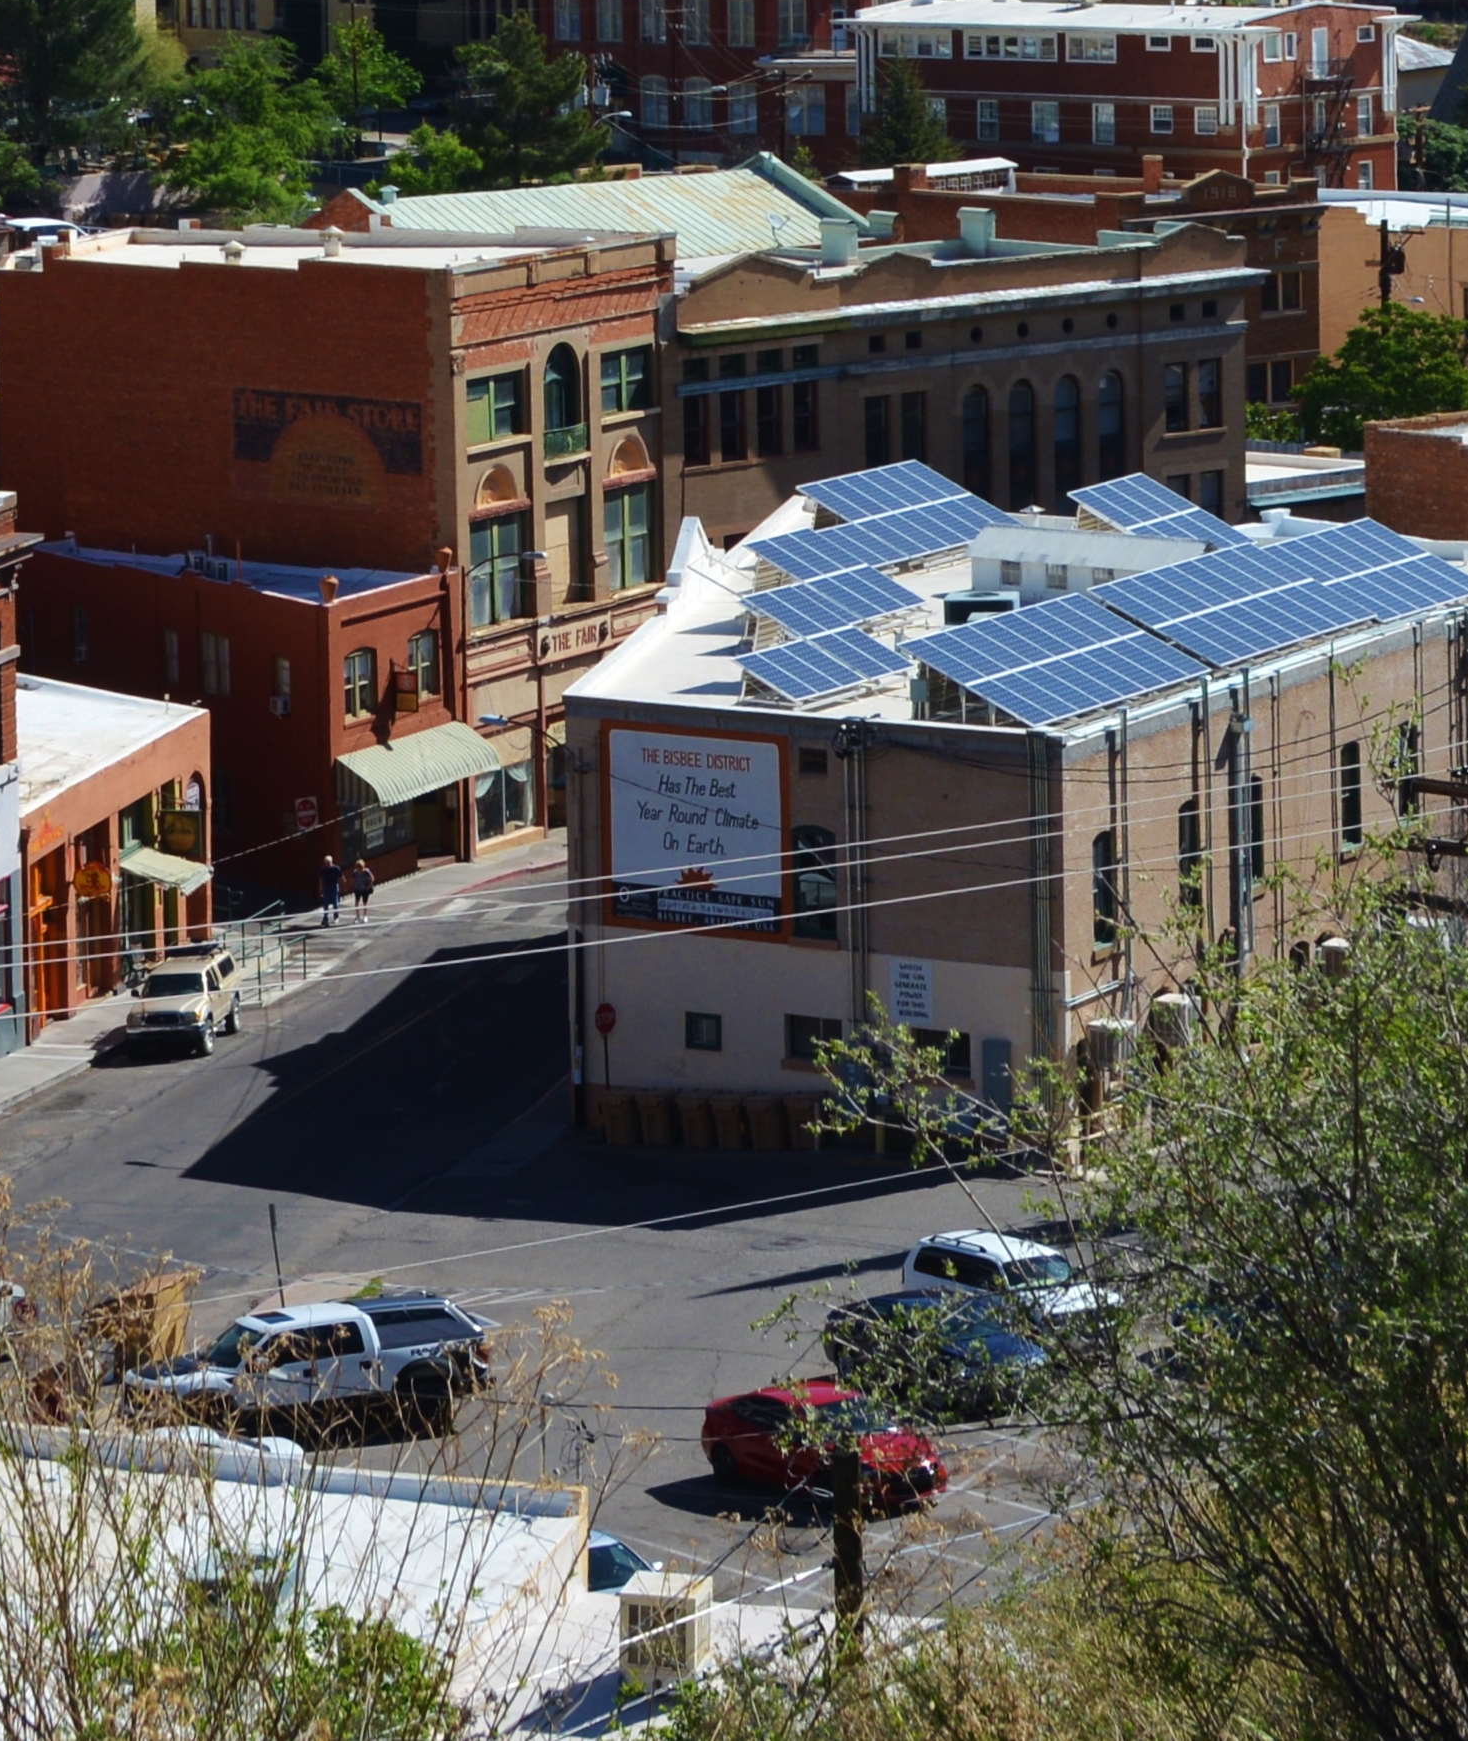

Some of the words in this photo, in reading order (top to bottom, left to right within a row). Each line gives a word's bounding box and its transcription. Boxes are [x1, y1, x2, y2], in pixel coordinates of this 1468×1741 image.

[1204, 186, 1237, 200] 1918
[234, 390, 277, 421] THE
[346, 403, 420, 432] STORE
[552, 631, 572, 653] THE
[576, 625, 597, 647] FAIR
[642, 747, 660, 765] THE
[663, 749, 702, 769] BISBEE
[706, 753, 751, 773] DISTRICT
[658, 773, 681, 795] Has
[684, 776, 706, 797] The
[709, 778, 736, 799] Best
[637, 800, 663, 822] Year
[668, 803, 709, 826] Round
[714, 807, 760, 830] Climate
[663, 831, 679, 852] On
[687, 833, 727, 856] Earth.
[657, 889, 710, 903] PRACTICE
[718, 894, 743, 906] SAFE
[750, 896, 775, 908] SUN
[754, 922, 775, 933] USA
[596, 1011, 615, 1026] STOP
